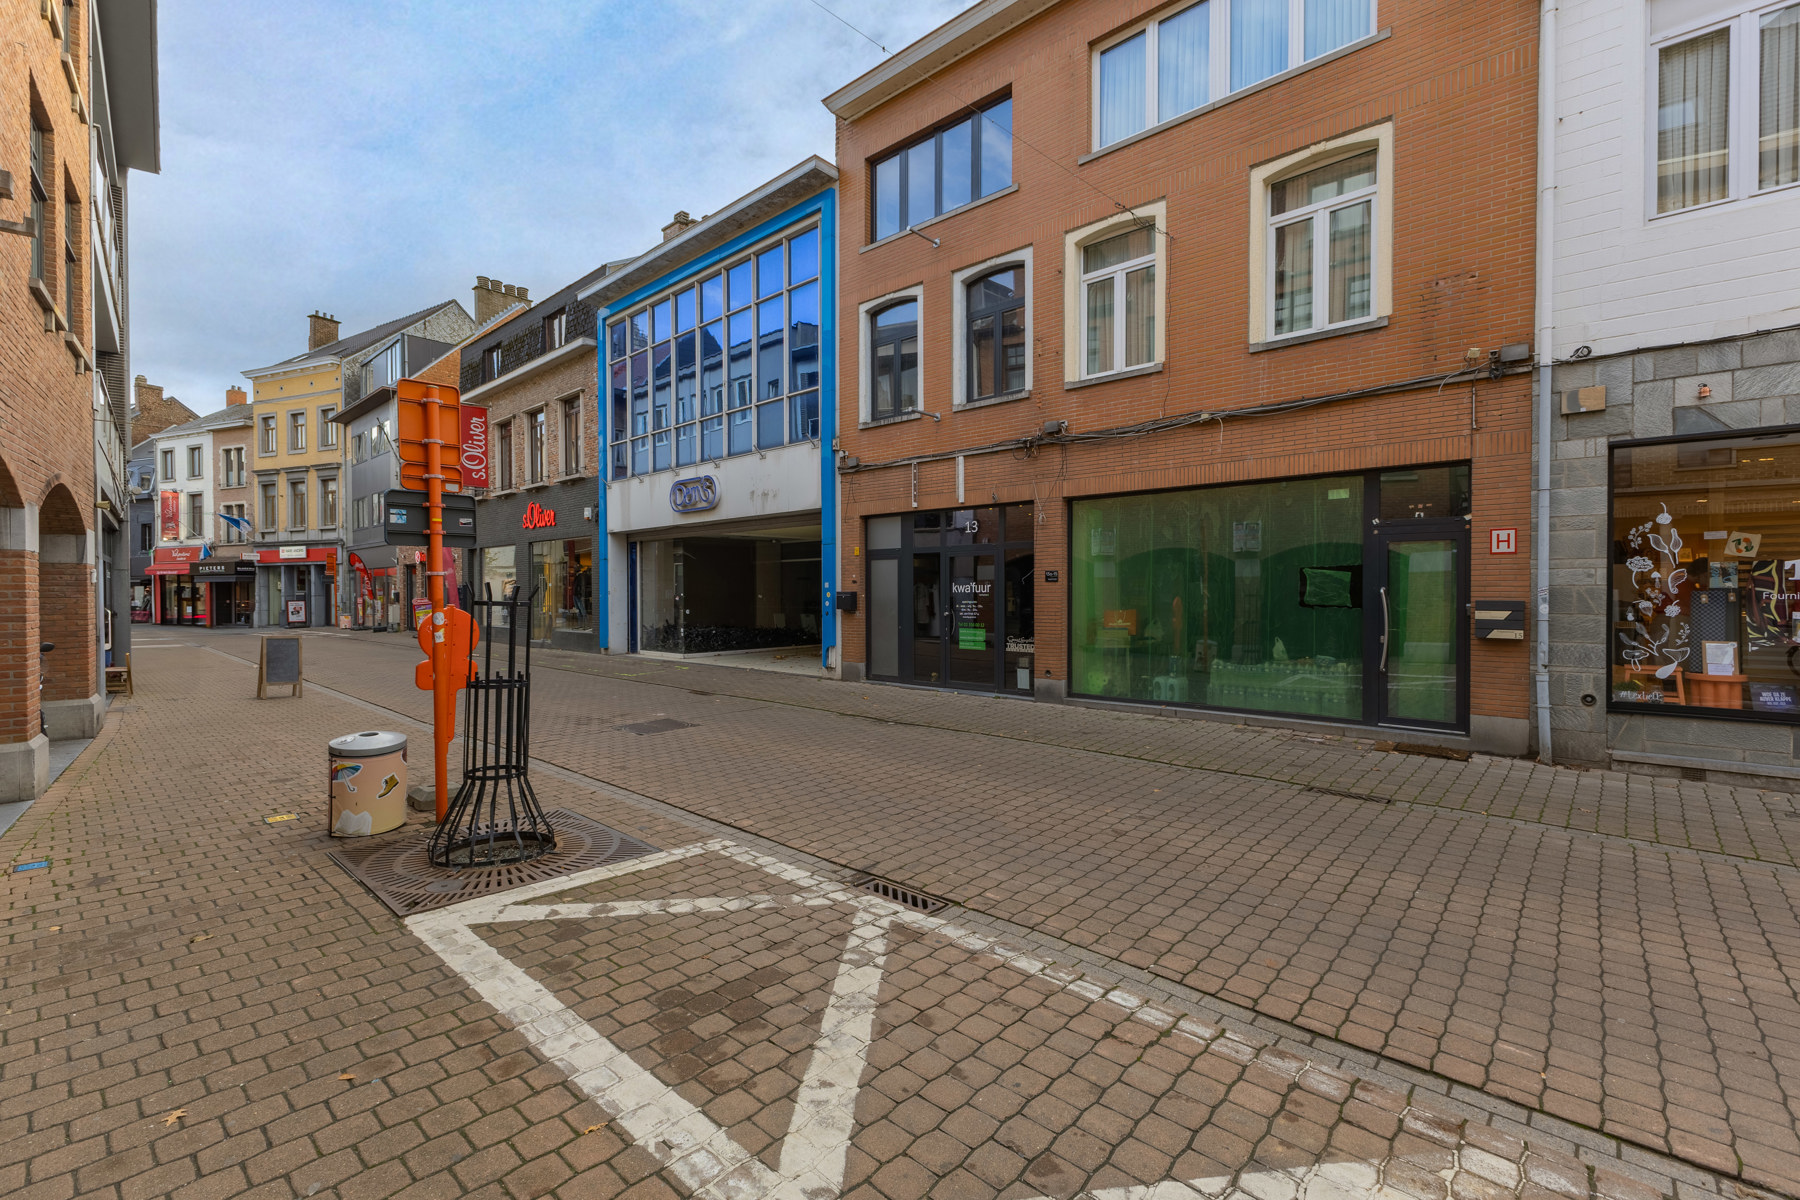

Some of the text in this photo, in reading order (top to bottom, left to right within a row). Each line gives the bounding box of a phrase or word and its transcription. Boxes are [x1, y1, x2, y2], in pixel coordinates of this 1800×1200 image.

[461, 416, 487, 480] s.Oliver
[522, 501, 556, 529] s.Oliver
[965, 520, 979, 533] 13
[1496, 533, 1511, 550] H
[1006, 642, 1034, 650] TRUSTED
